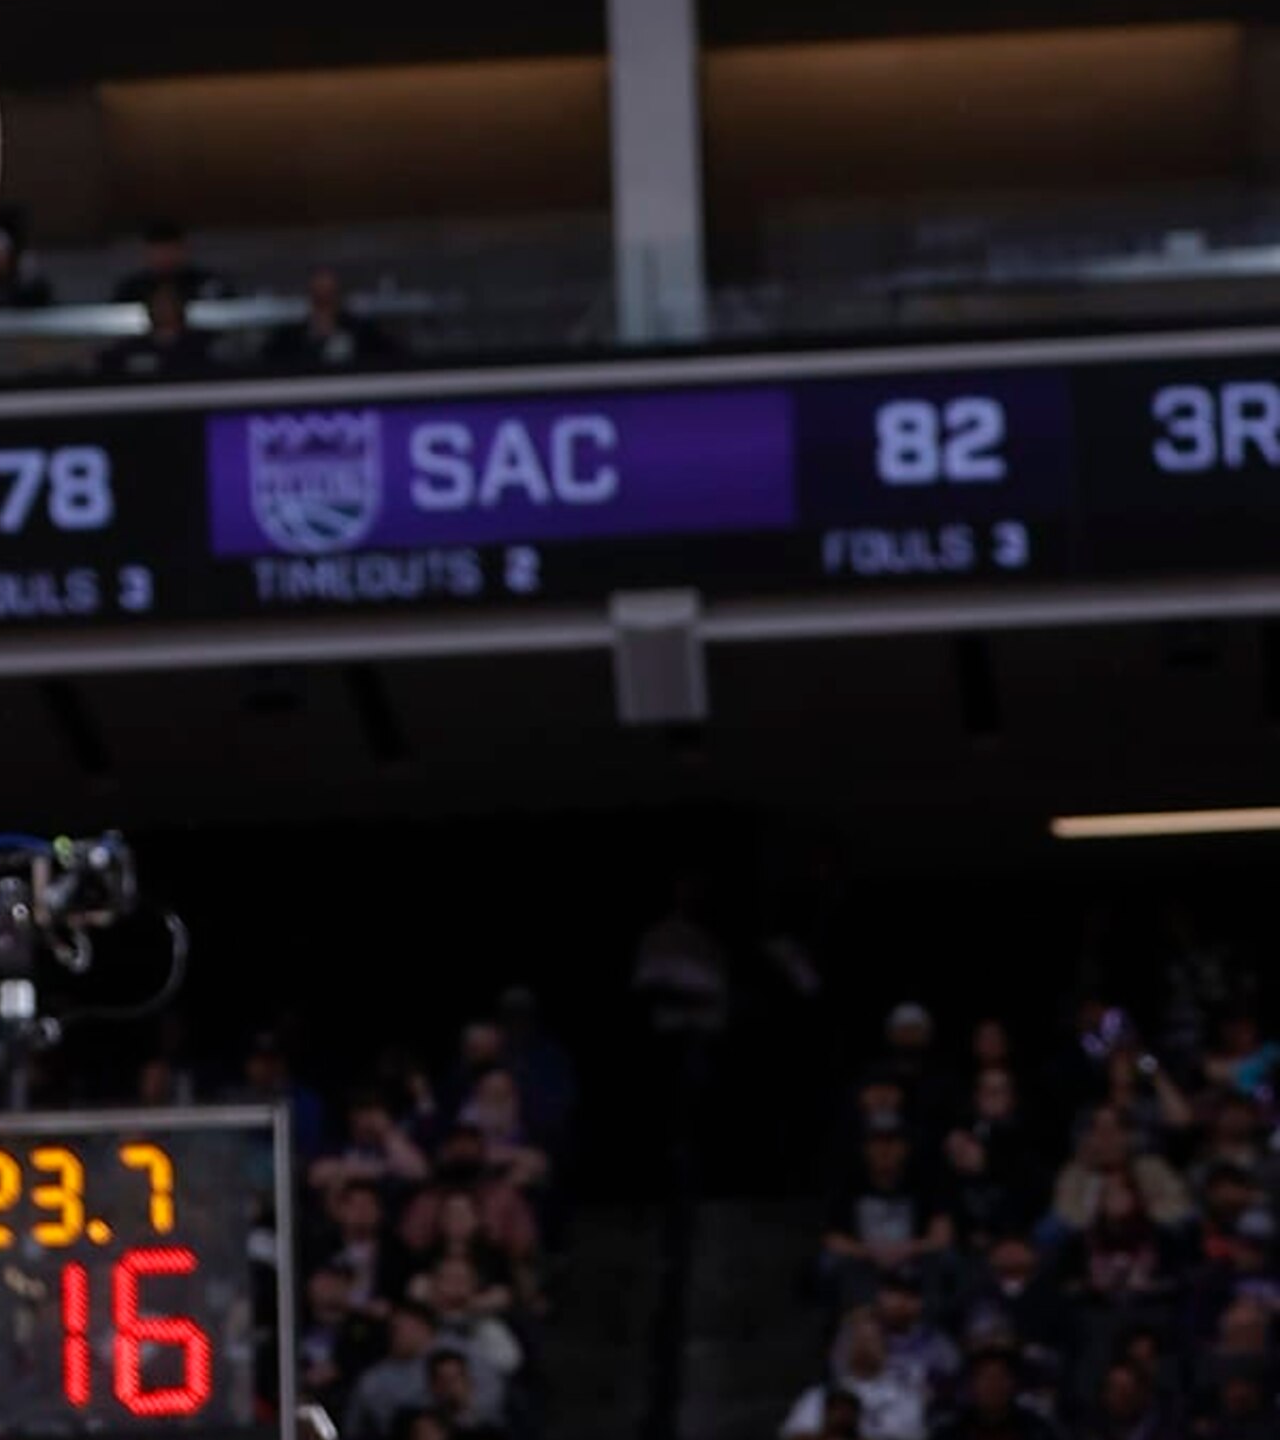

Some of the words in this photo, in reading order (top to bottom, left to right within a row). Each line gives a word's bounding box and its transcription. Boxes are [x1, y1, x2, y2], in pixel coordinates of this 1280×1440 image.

[409, 414, 618, 512] SAC
[875, 396, 1008, 485] 82
[252, 548, 485, 602] TIMEOUTS
[822, 523, 975, 575] FOULS
[60, 1245, 214, 1417] 16
